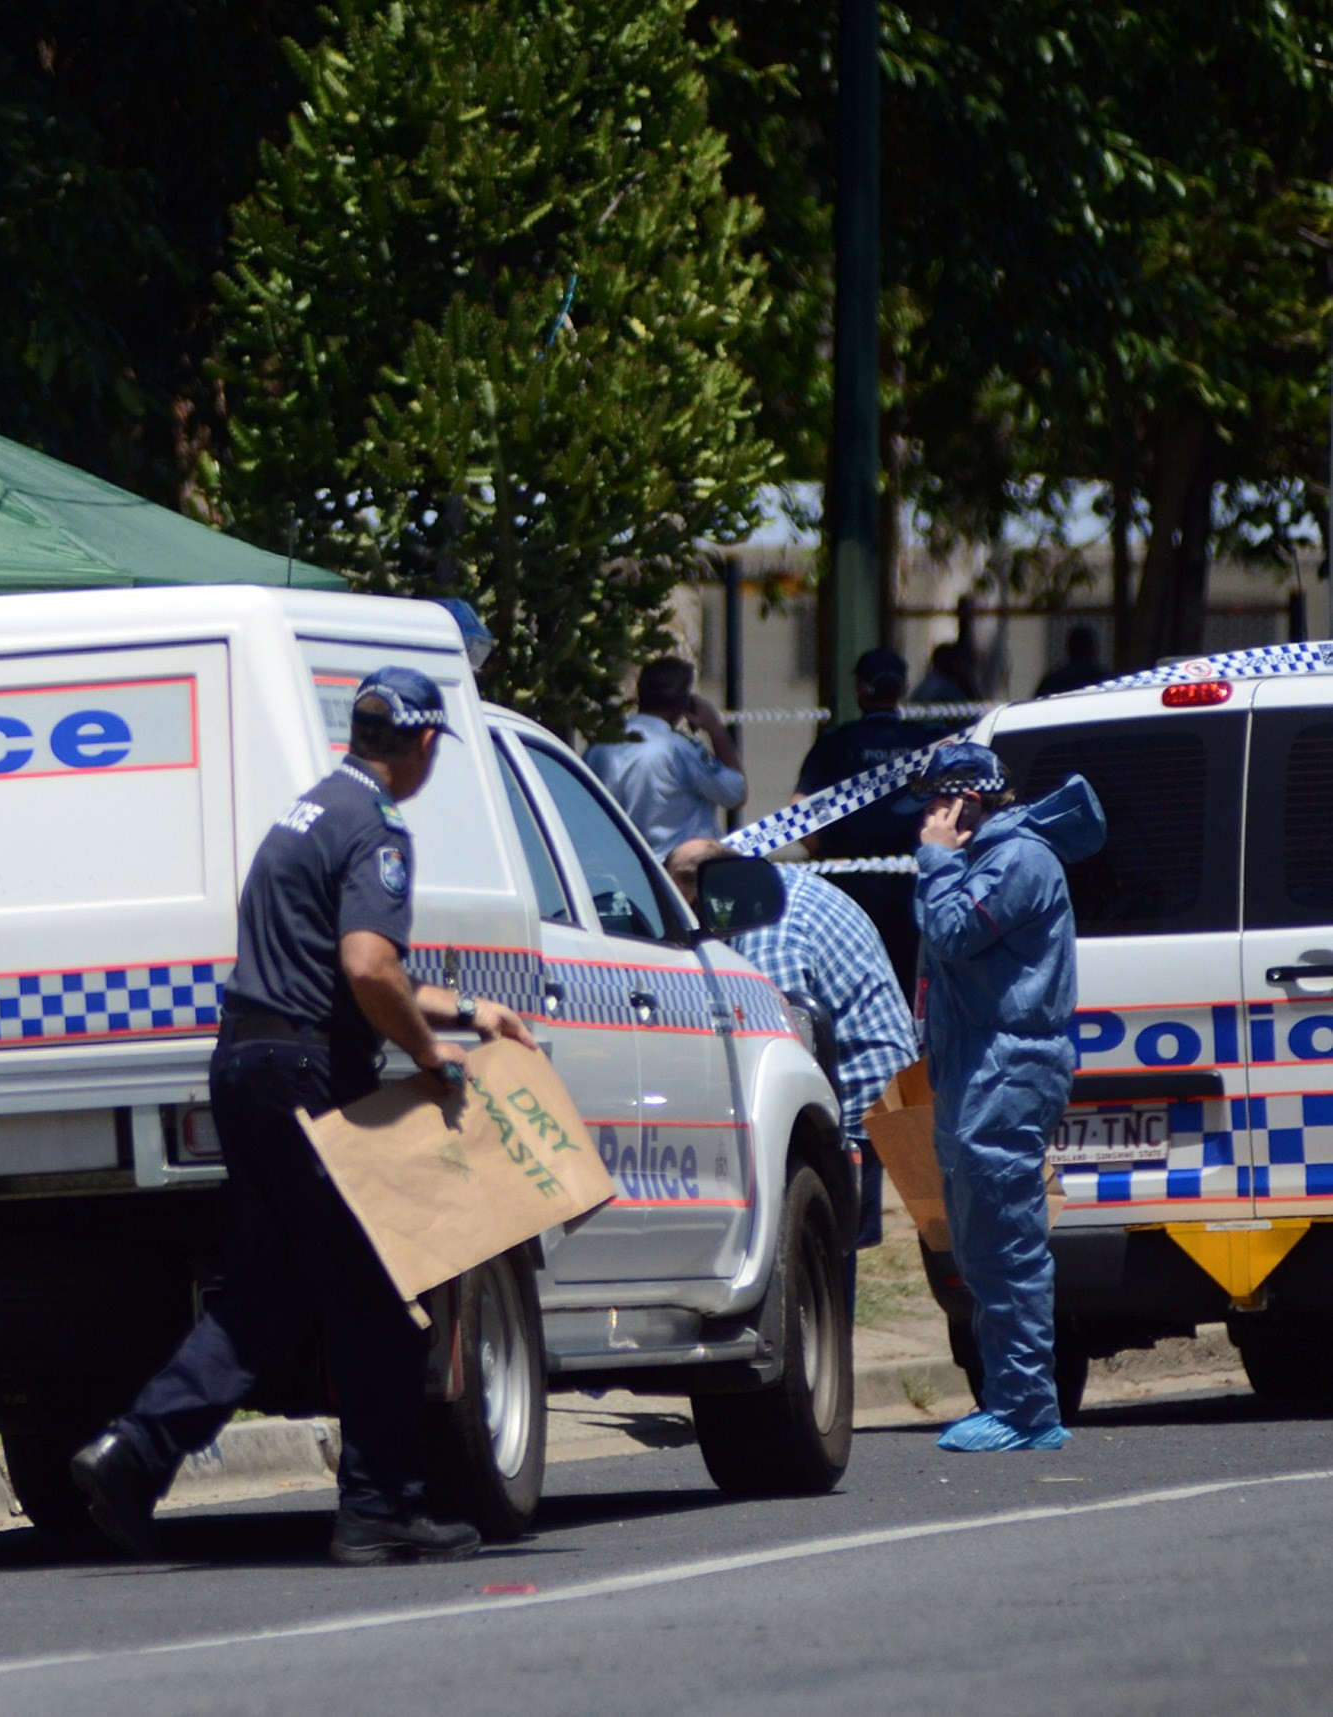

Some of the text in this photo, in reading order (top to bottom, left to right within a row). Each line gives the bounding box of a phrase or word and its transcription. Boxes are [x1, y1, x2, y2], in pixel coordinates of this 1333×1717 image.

[1067, 1003, 1333, 1069] Polic
[472, 1077, 565, 1199] WASTE
[506, 1087, 581, 1152] DRY
[598, 1125, 699, 1200] Police
